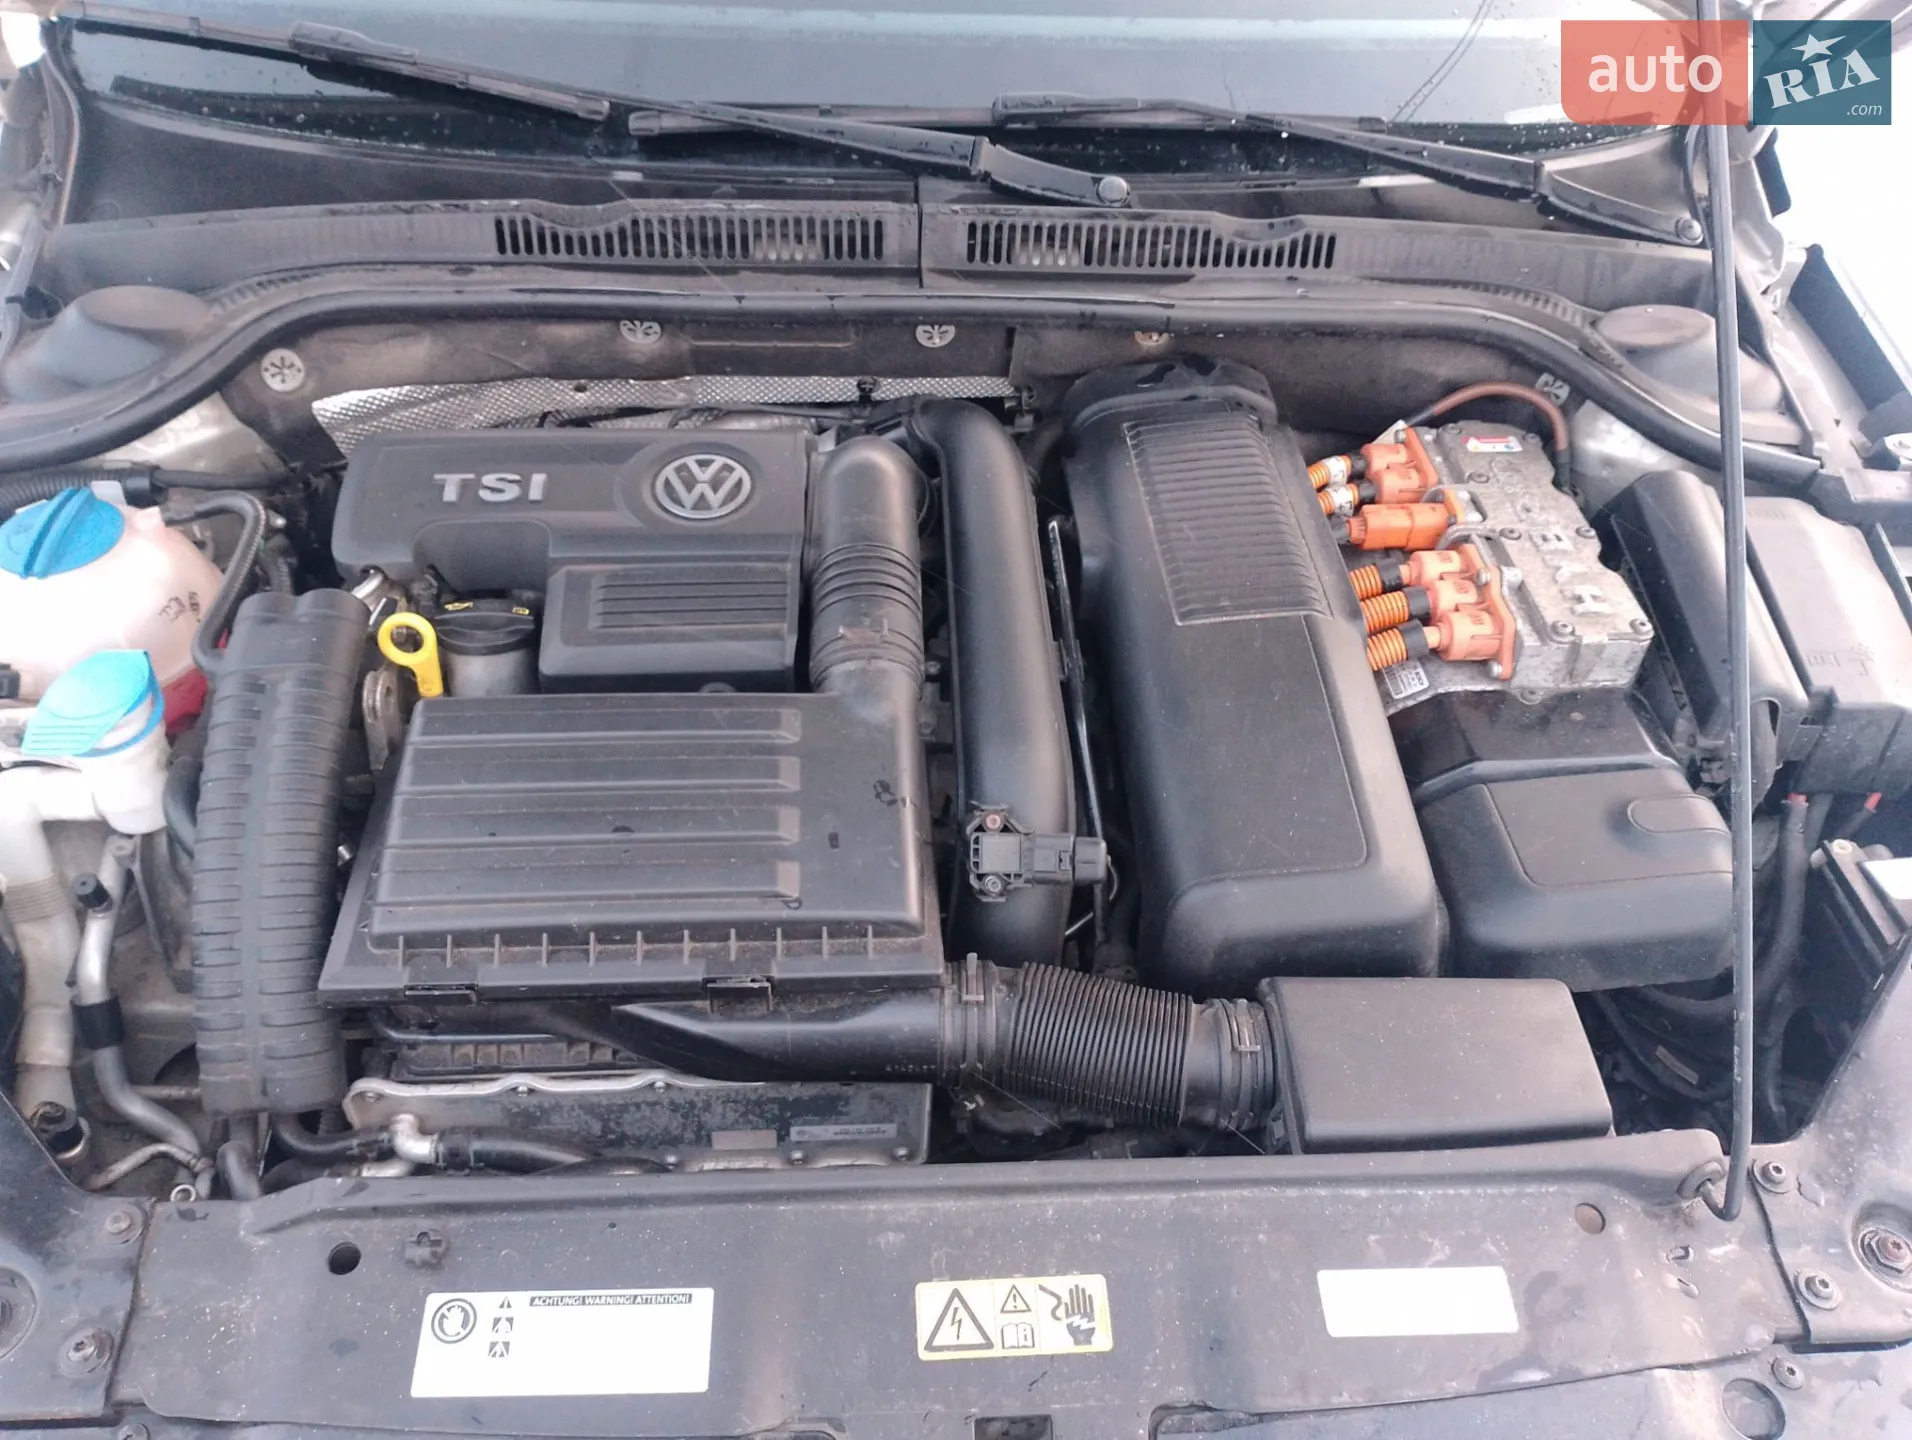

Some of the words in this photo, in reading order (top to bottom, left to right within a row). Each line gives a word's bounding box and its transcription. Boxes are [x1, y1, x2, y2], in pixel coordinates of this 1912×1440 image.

[433, 472, 548, 503] TSI
[532, 1296, 582, 1306] ACHTUNG!
[585, 1295, 634, 1306] WARNING!
[635, 1293, 691, 1305] ATTENTION!
